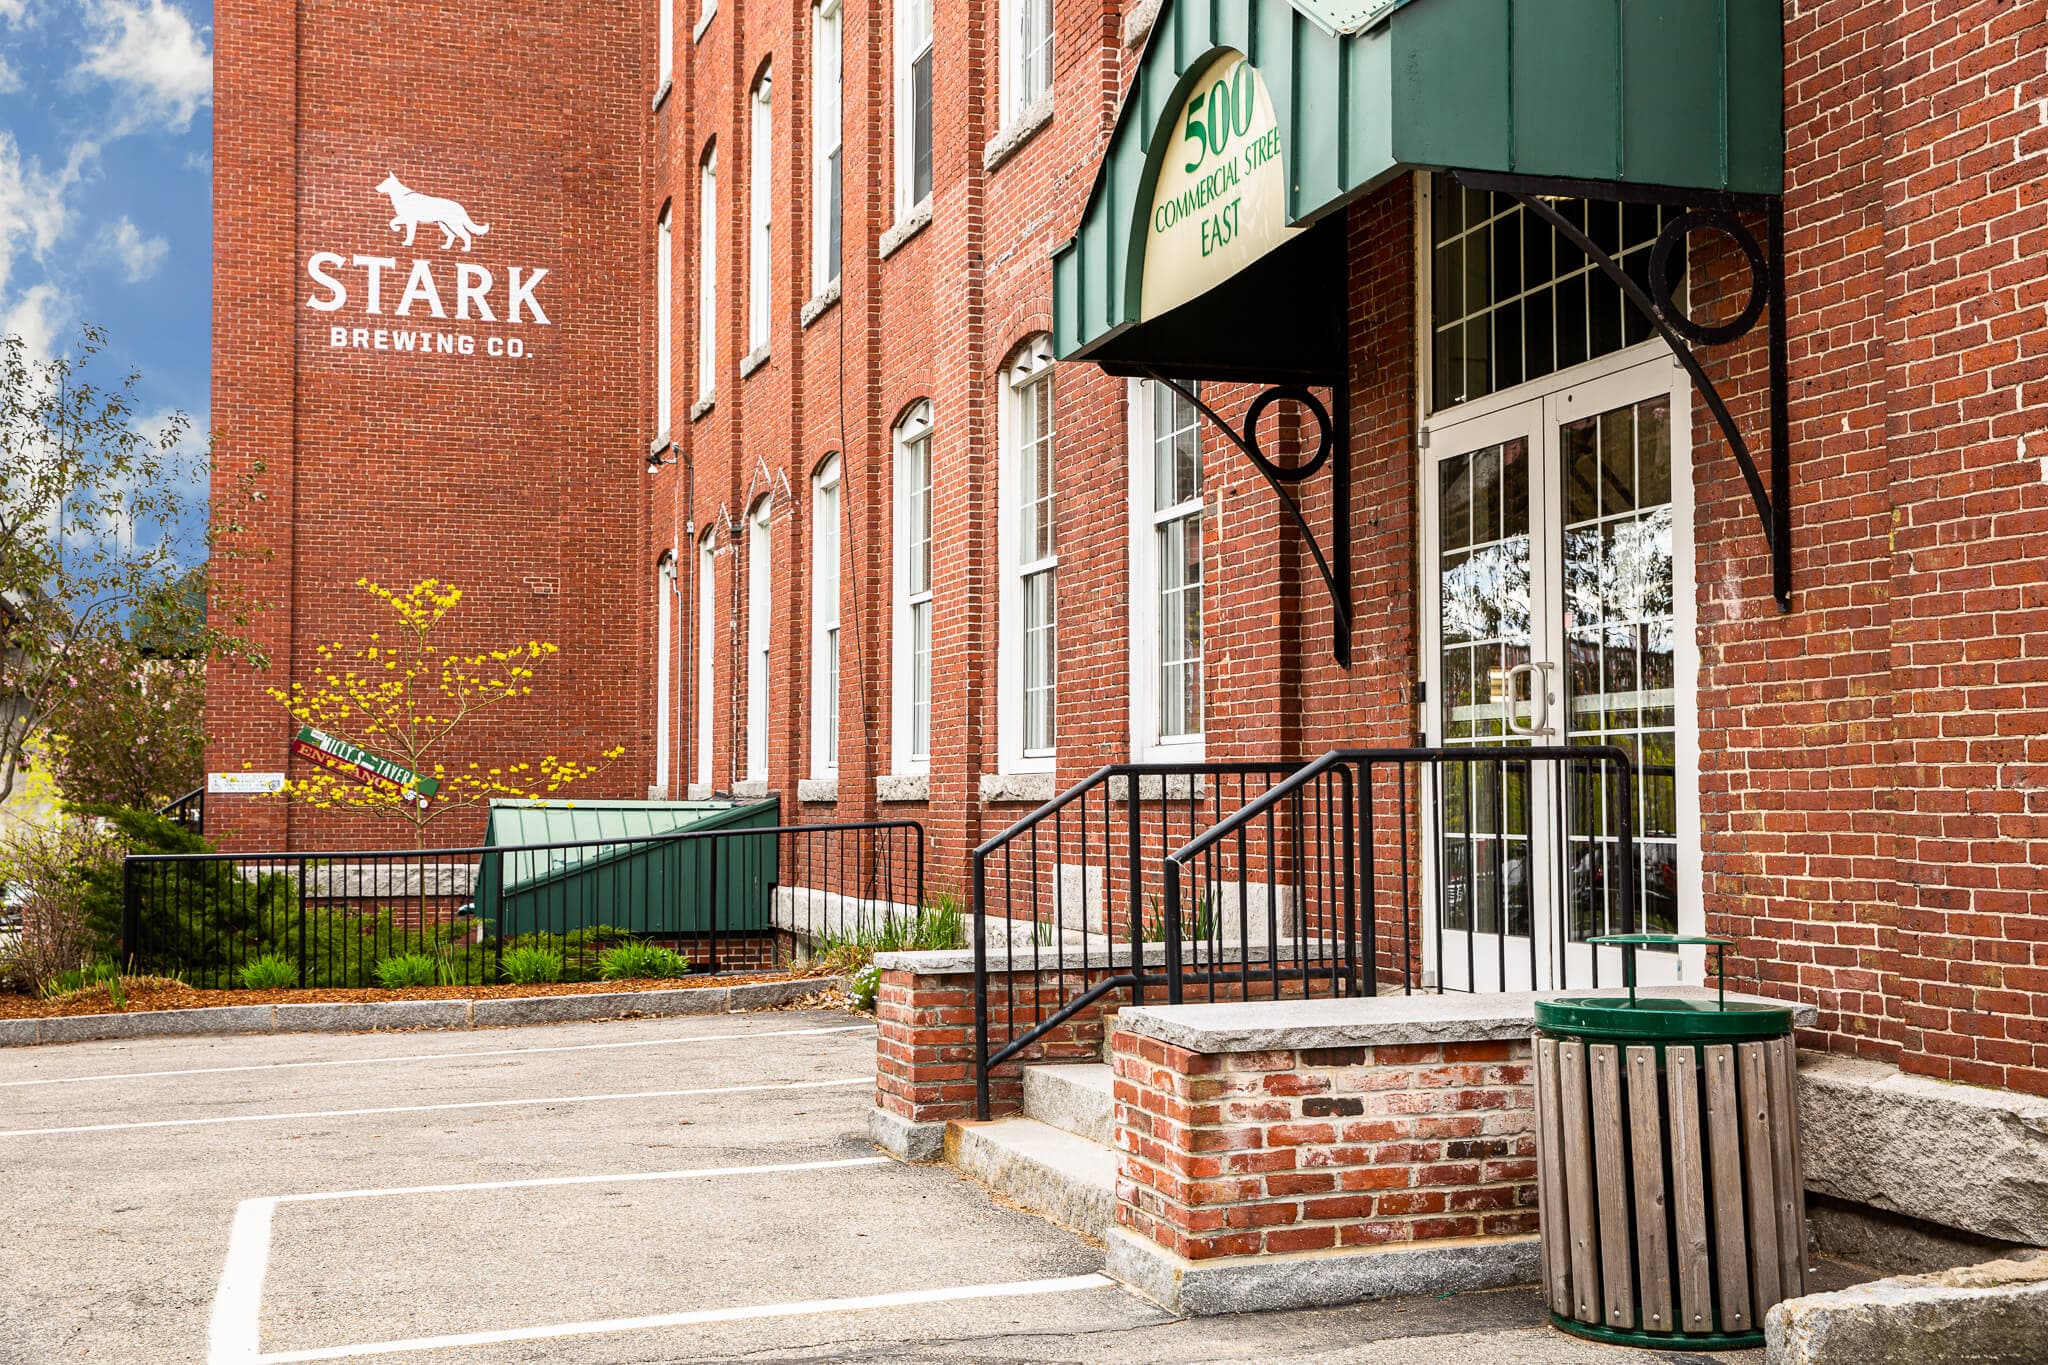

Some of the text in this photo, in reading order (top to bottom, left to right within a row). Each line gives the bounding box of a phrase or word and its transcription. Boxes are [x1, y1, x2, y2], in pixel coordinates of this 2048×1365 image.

[1185, 60, 1255, 174] 500
[1155, 126, 1281, 233] COMMERCIAL STREE
[1201, 198, 1241, 257] EAST
[306, 251, 551, 325] STARK
[330, 326, 533, 359] BREWING CO.
[297, 743, 400, 795] ENANC
